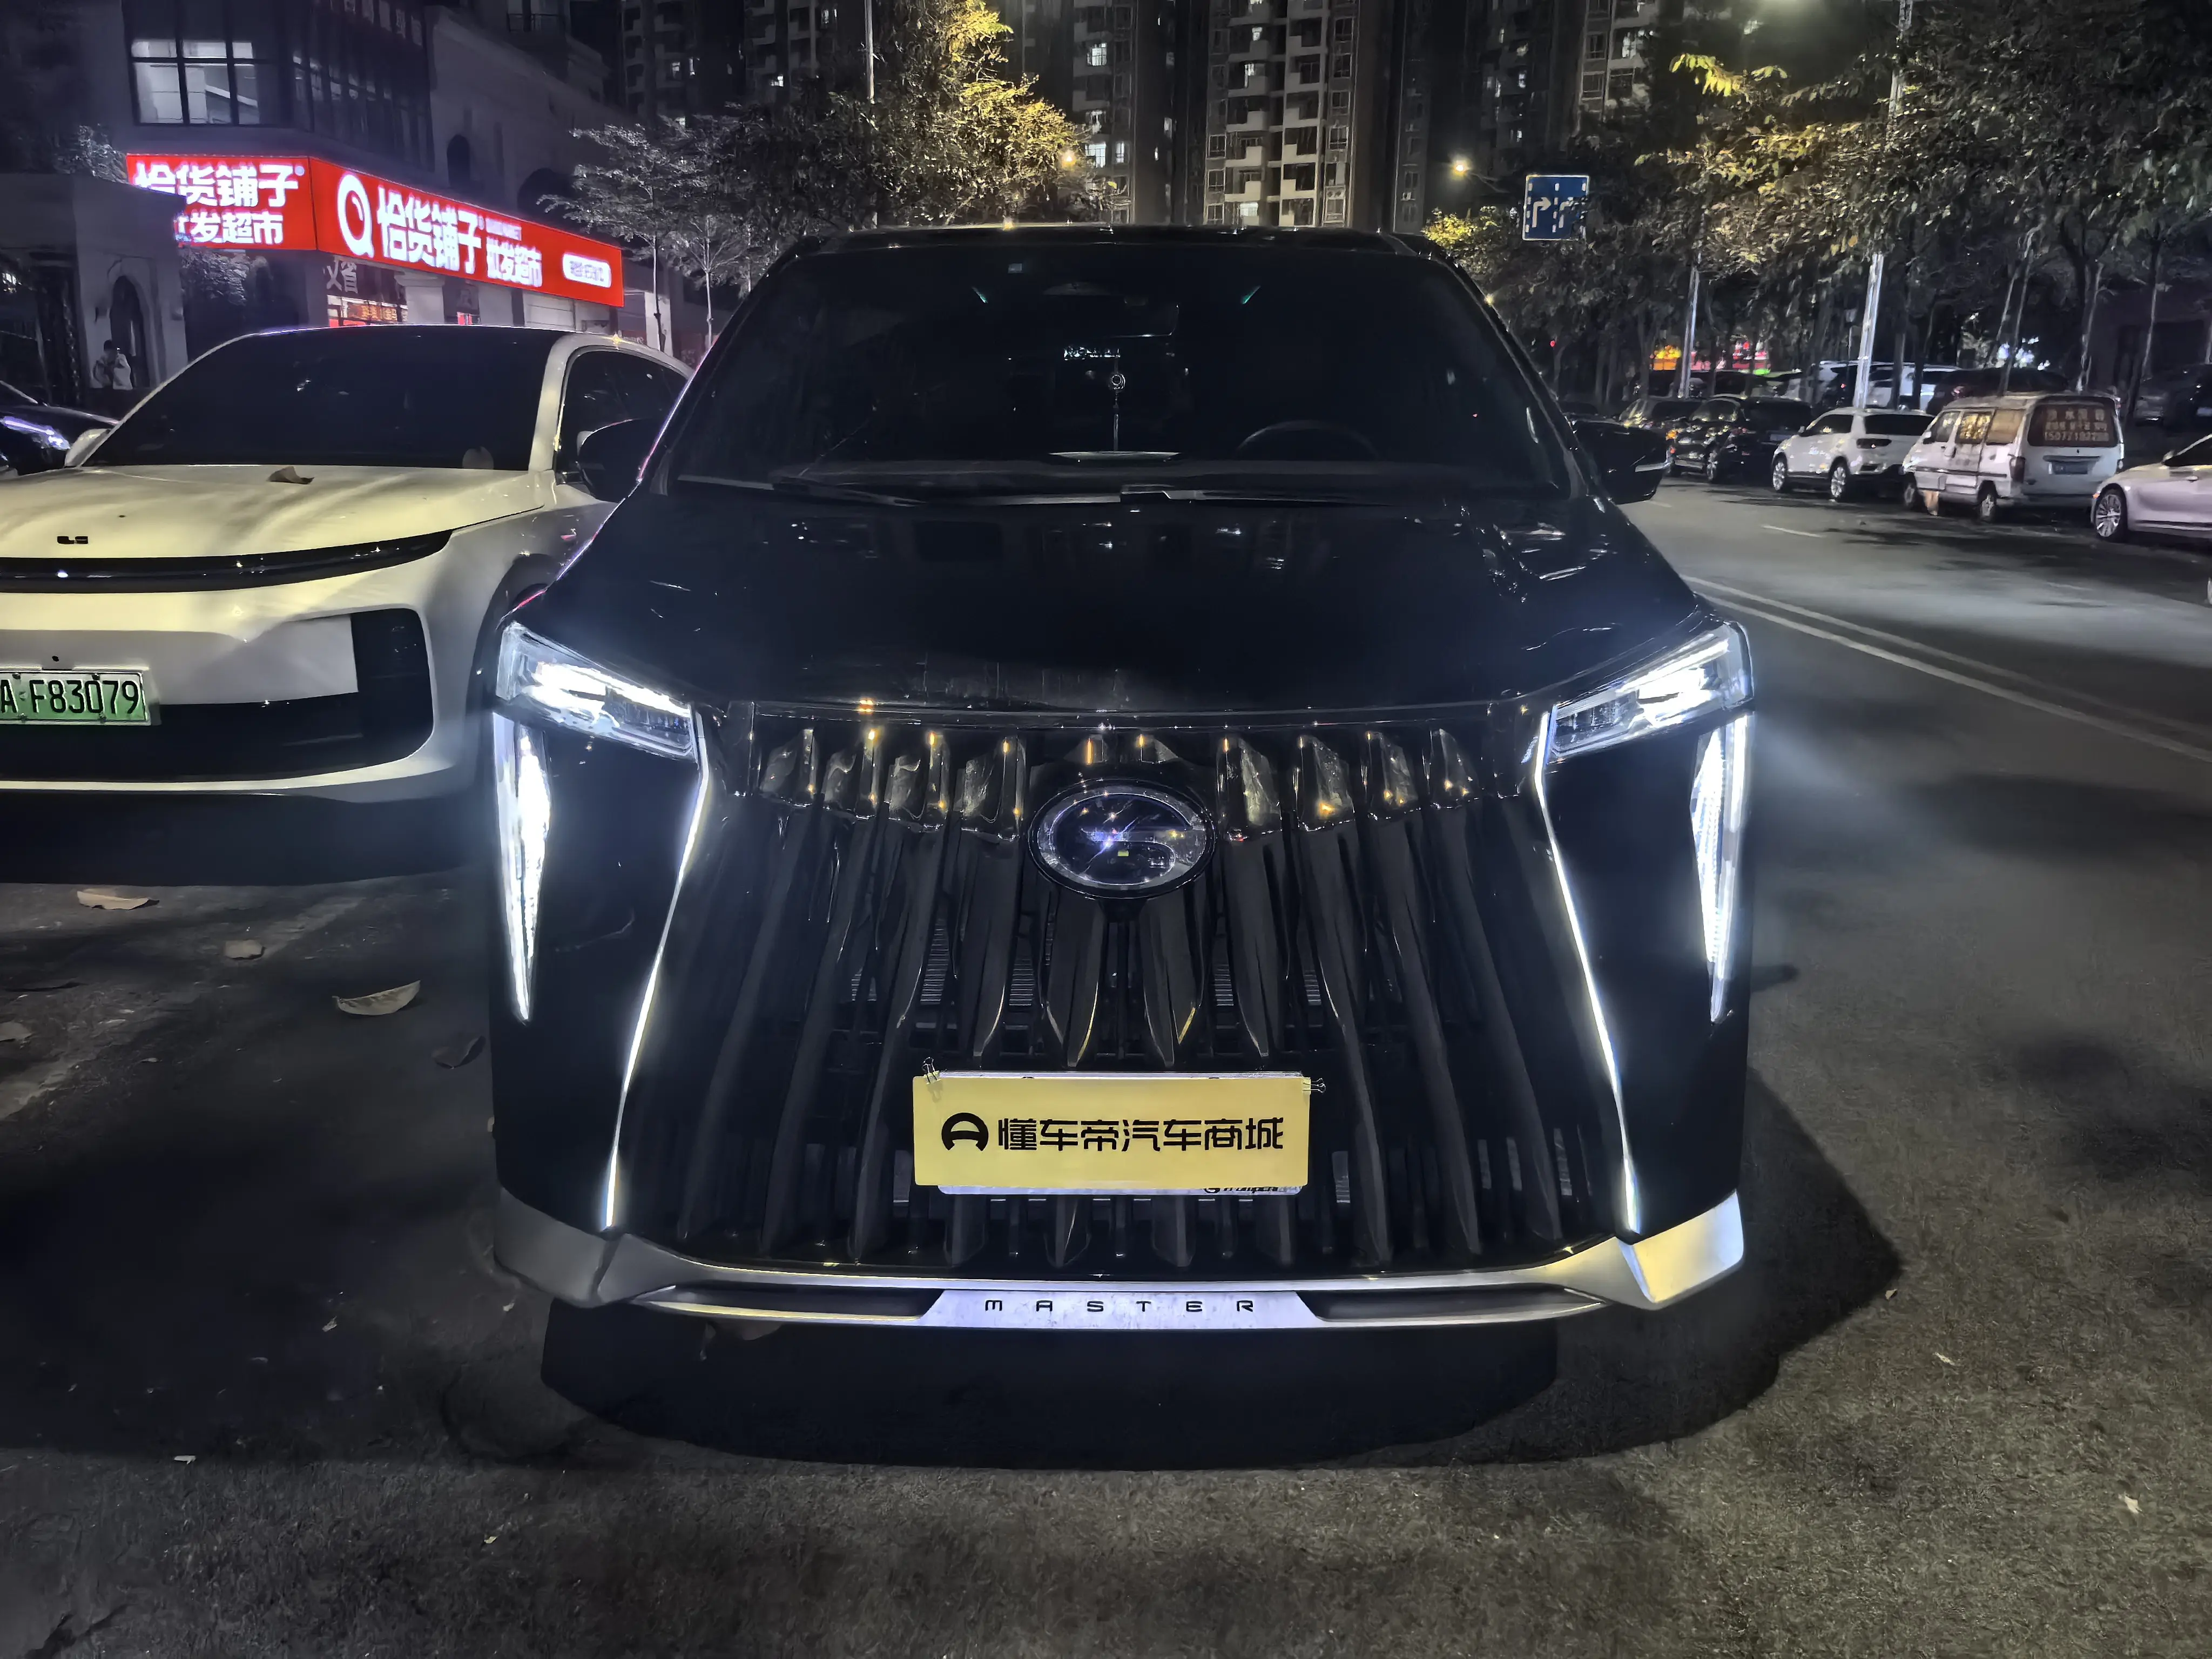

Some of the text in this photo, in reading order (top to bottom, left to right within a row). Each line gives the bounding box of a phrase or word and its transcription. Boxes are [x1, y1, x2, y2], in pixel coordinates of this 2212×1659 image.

[377, 186, 480, 274] 恰货铺子
[998, 1117, 1284, 1152] 懂车帝汽车商城
[984, 1299, 1254, 1313] MASTER
